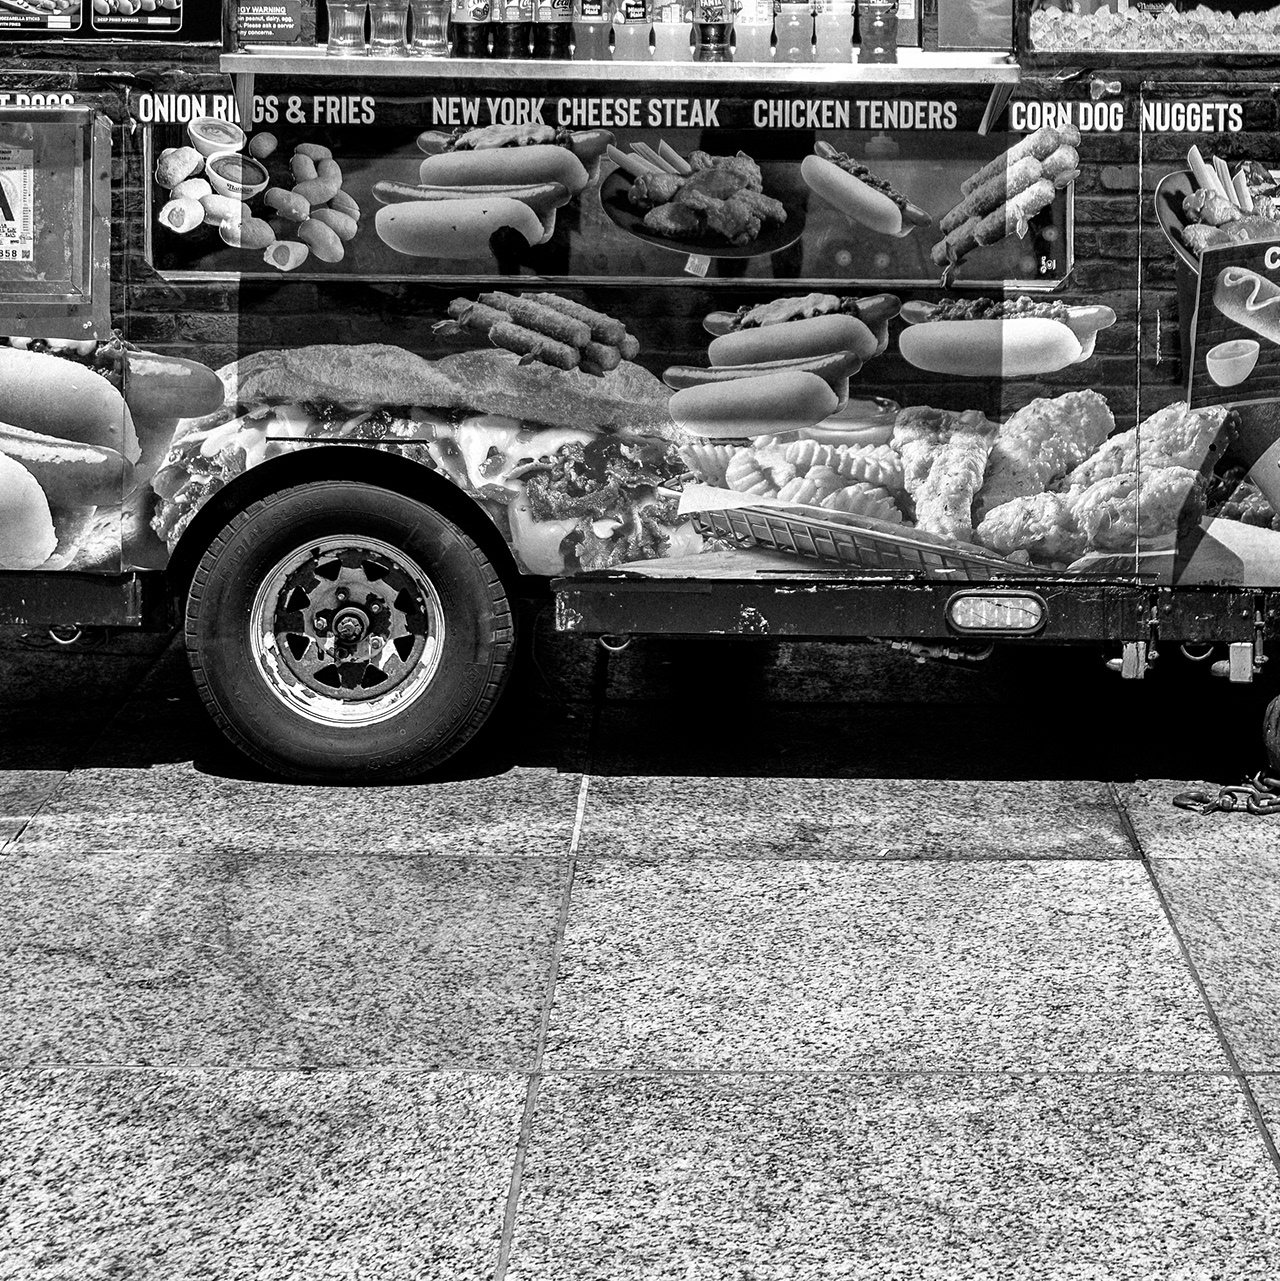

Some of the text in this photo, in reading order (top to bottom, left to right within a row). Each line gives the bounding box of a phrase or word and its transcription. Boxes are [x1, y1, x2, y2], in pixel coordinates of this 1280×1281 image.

[252, 6, 287, 14] WARNING
[140, 94, 206, 123] ONION
[286, 97, 307, 123] &
[313, 96, 376, 125] FRIES
[432, 97, 721, 127] NEW YORK CHEESE STEAK
[754, 99, 958, 129] CHICKEN TENDERS
[1013, 101, 1243, 132] CORN DOG NUGGETS
